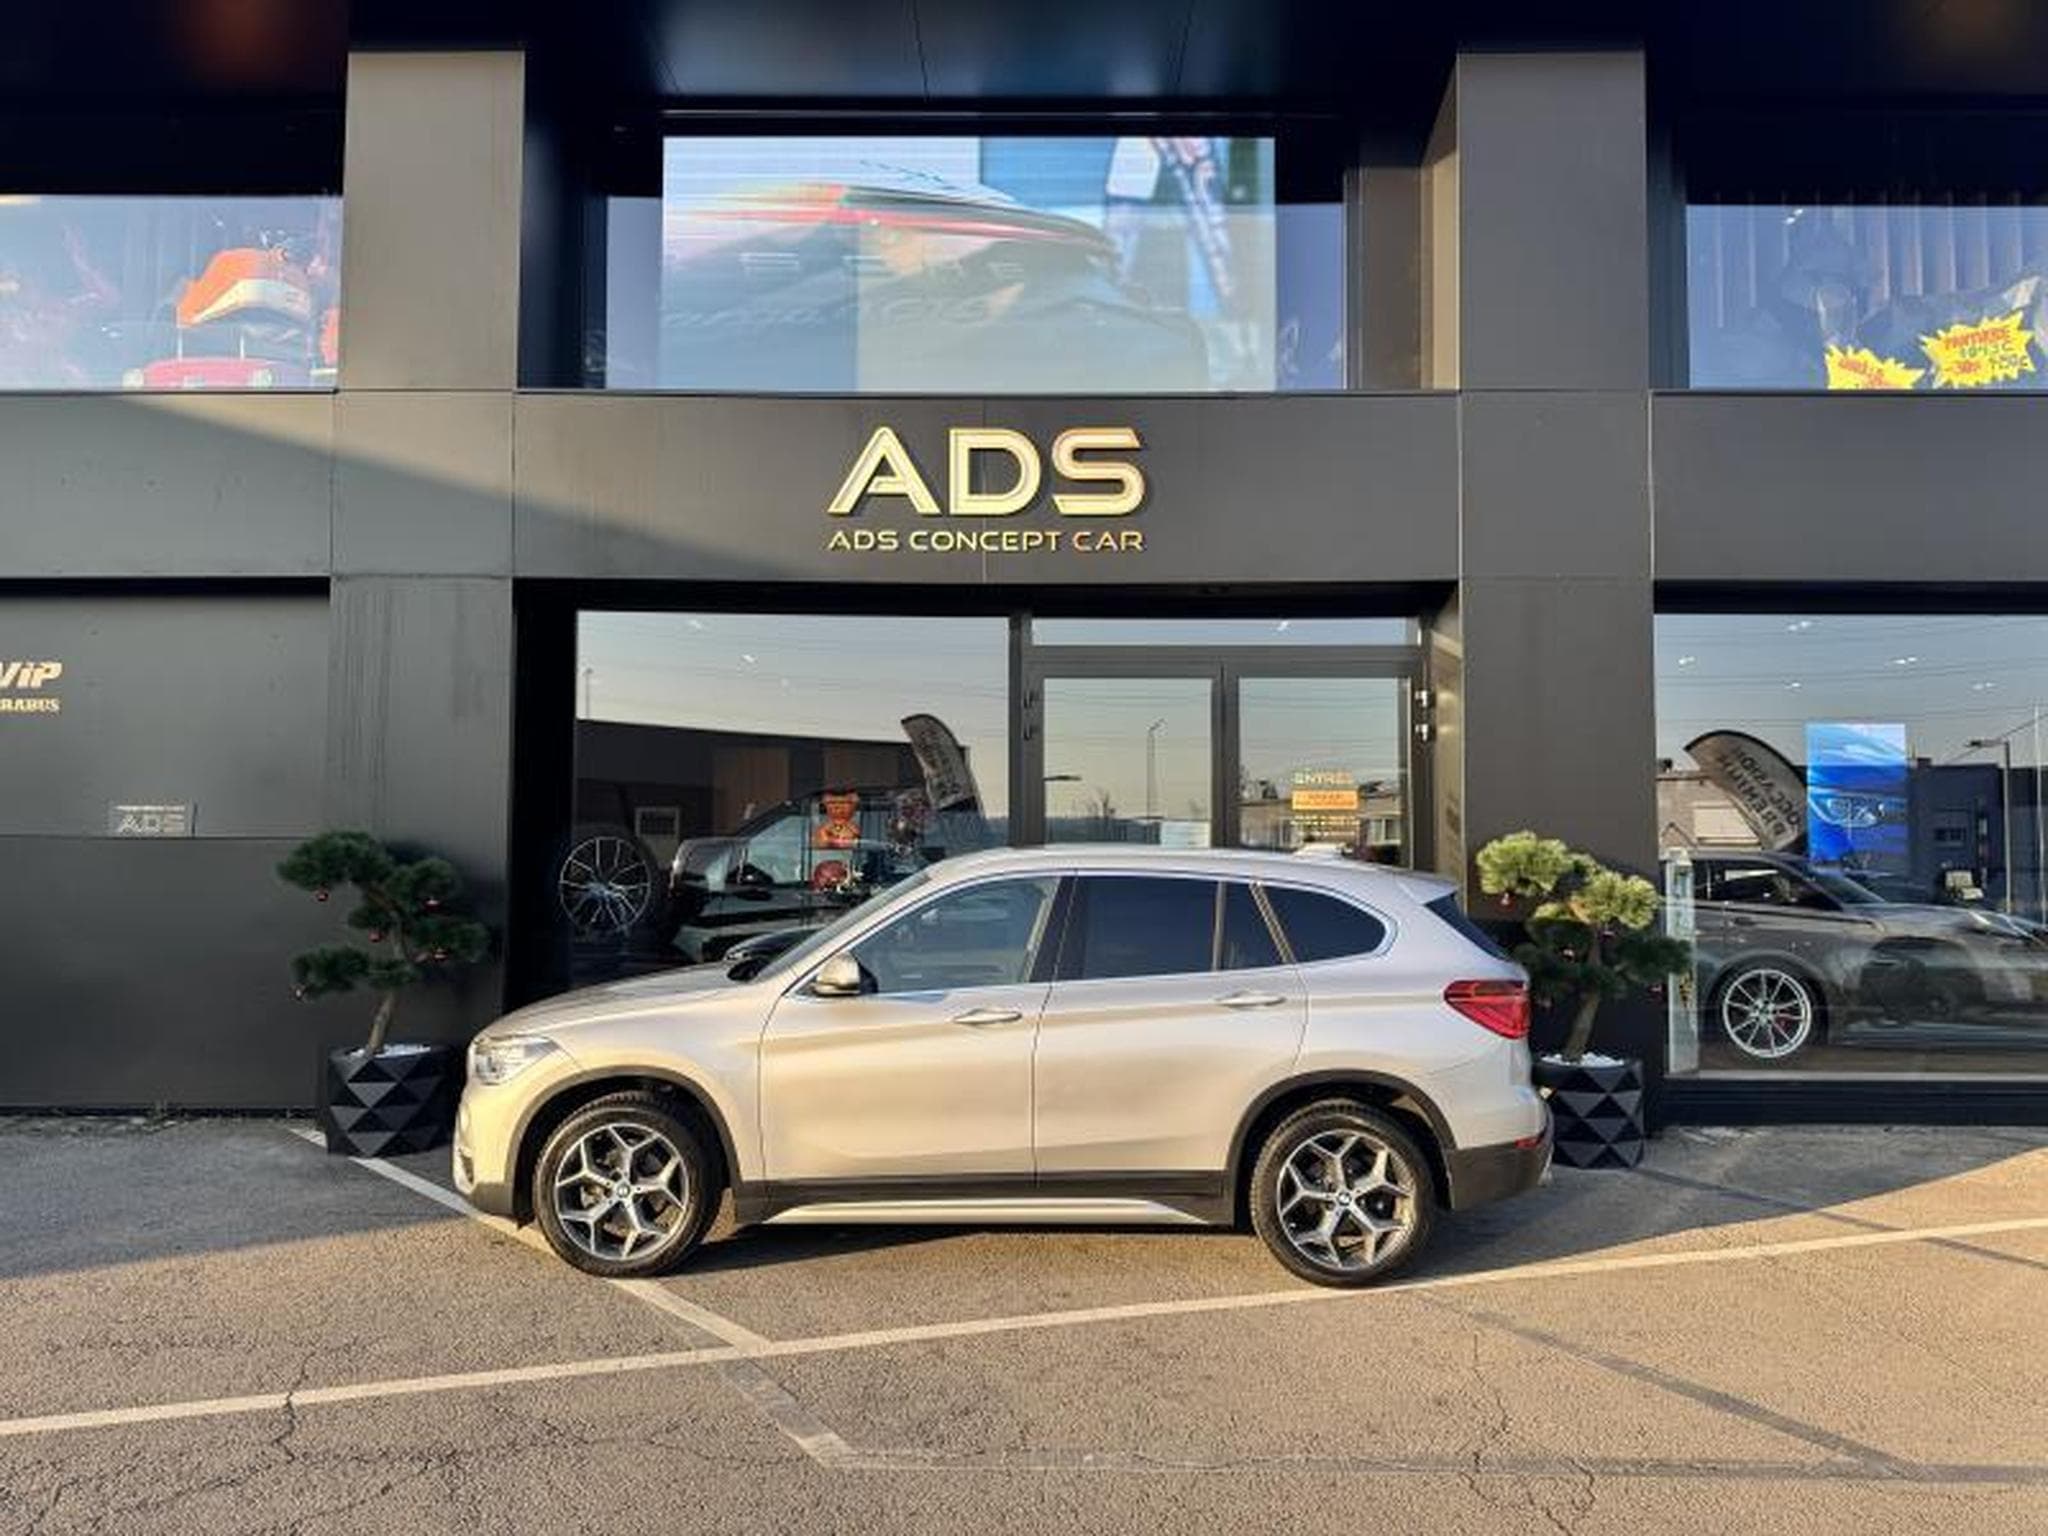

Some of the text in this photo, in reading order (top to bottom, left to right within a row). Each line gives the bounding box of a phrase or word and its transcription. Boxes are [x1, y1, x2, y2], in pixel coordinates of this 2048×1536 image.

[827, 426, 1145, 516] ADS
[827, 530, 1145, 552] ADS CONCEPT CAR
